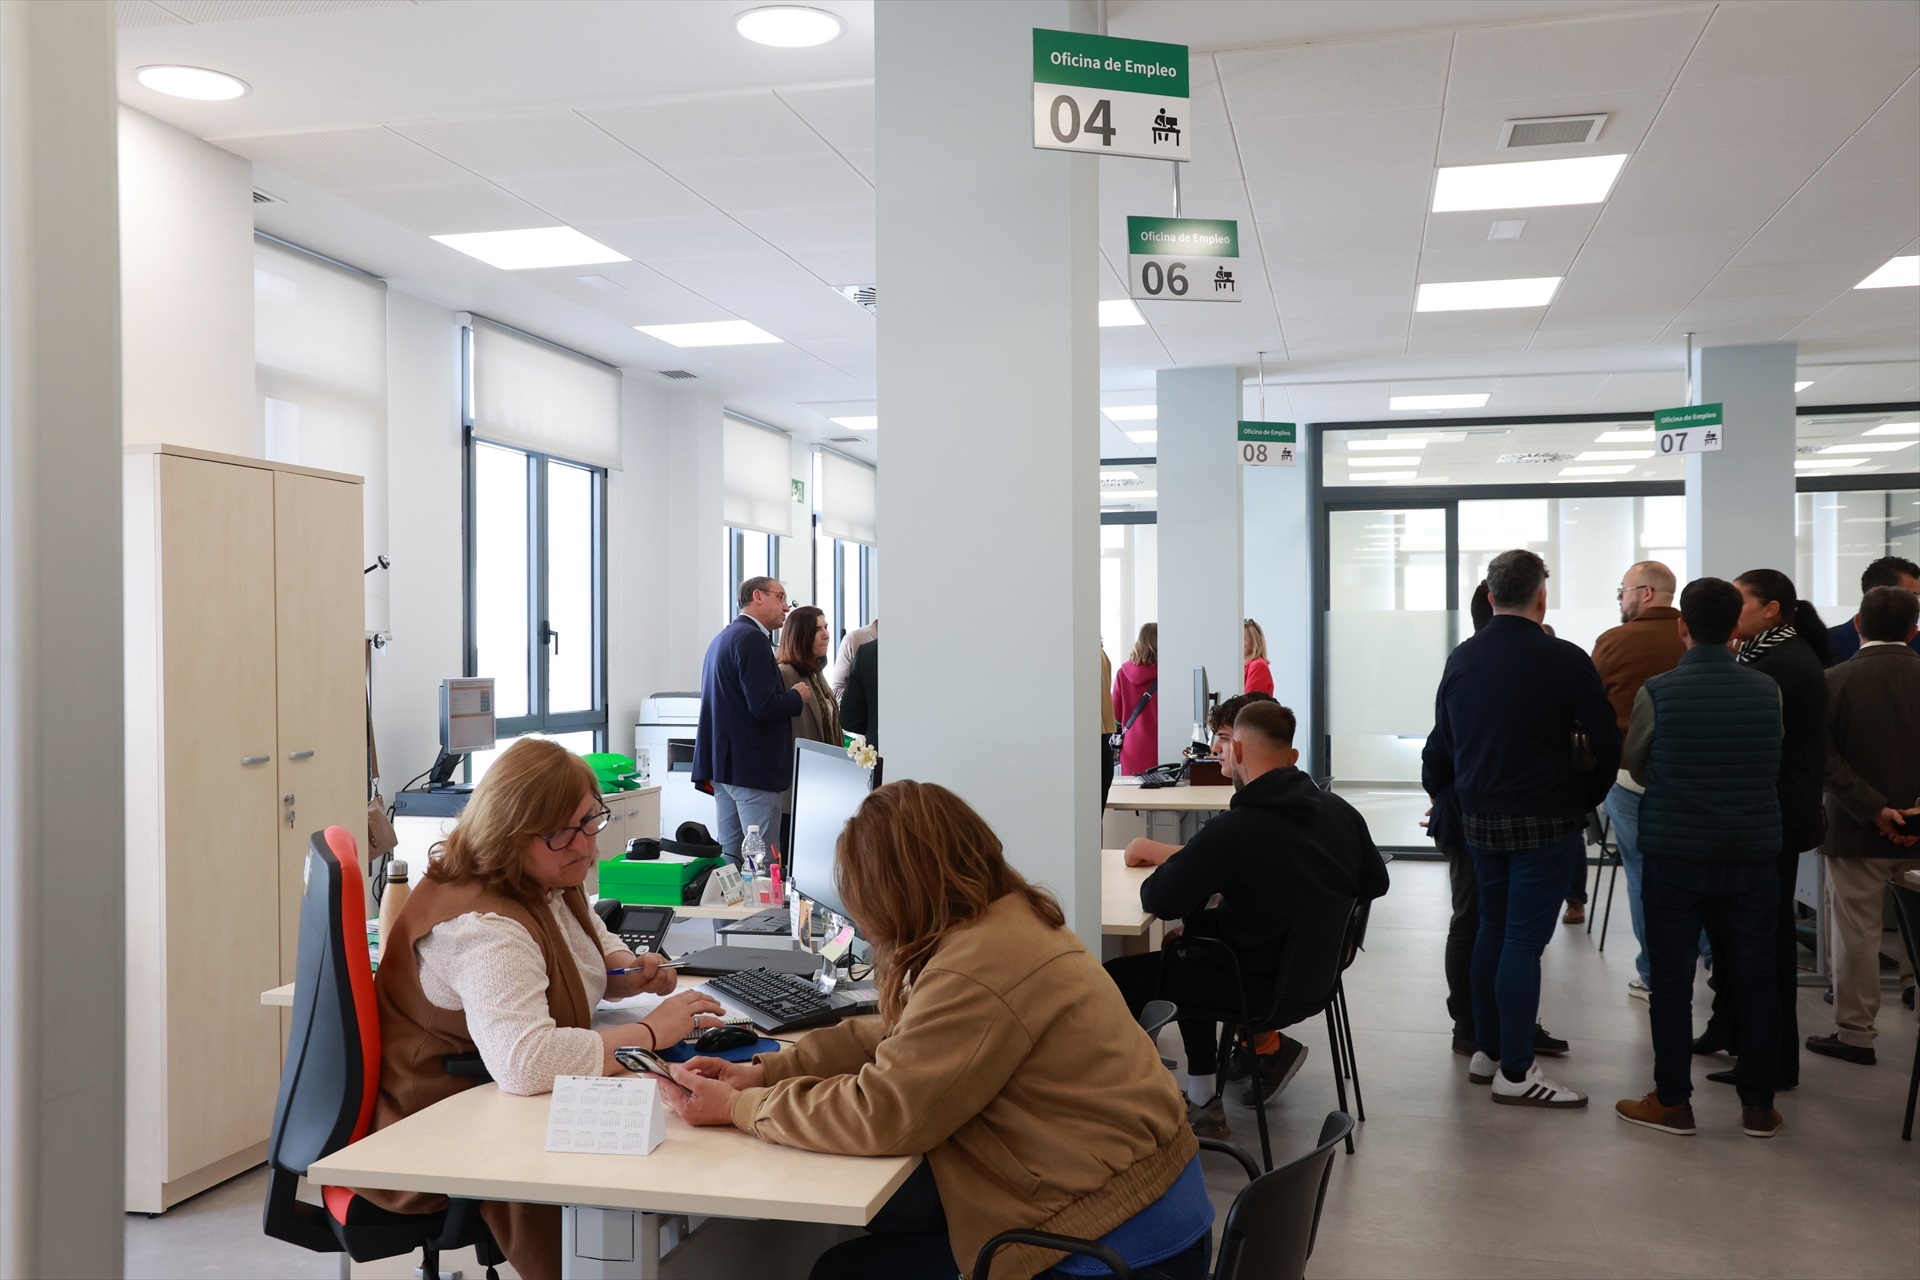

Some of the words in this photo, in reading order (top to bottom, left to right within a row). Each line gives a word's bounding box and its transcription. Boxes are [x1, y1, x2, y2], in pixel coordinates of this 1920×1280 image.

[1050, 51, 1101, 69] Oficina
[1104, 57, 1121, 71] de
[1125, 59, 1177, 78] Empleo
[1050, 94, 1116, 147] 04
[1140, 231, 1176, 242] Oficina
[1178, 233, 1191, 242] de
[1193, 233, 1230, 245] Empleo
[1142, 261, 1189, 296] 06
[1660, 416, 1683, 424] Oficina
[1692, 412, 1717, 420] Empleo
[1270, 429, 1291, 437] Empleo
[1660, 432, 1688, 453] 07
[1243, 443, 1268, 463] 08
